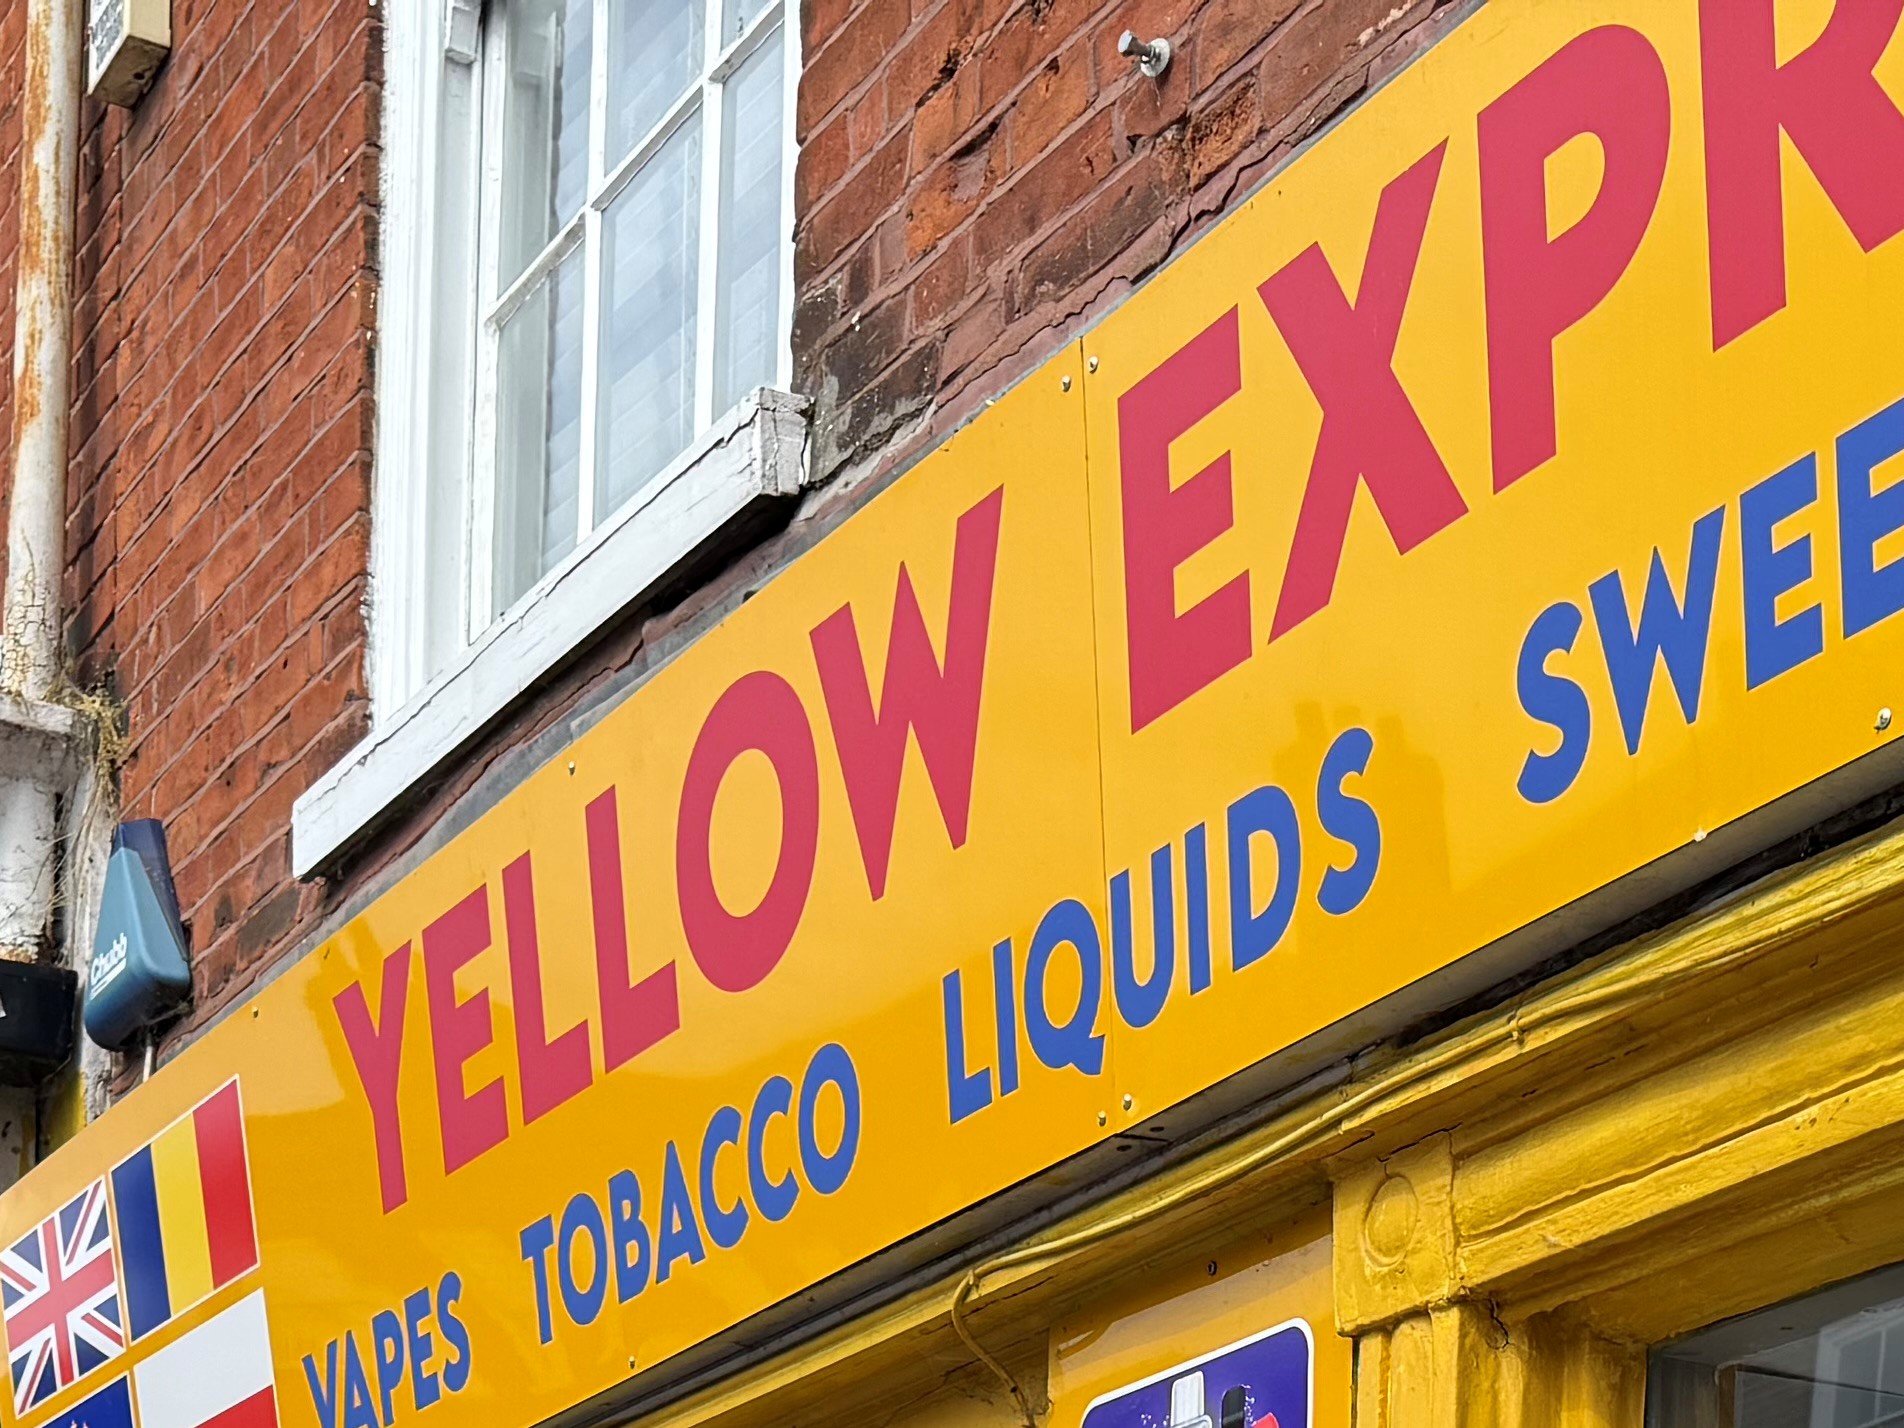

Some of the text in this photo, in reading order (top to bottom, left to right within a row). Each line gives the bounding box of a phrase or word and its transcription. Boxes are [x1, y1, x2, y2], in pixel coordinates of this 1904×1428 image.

[334, 488, 1004, 1211] YELLOW
[522, 1045, 860, 1342] TOBACCO
[945, 729, 1380, 1122] LIQUIDS
